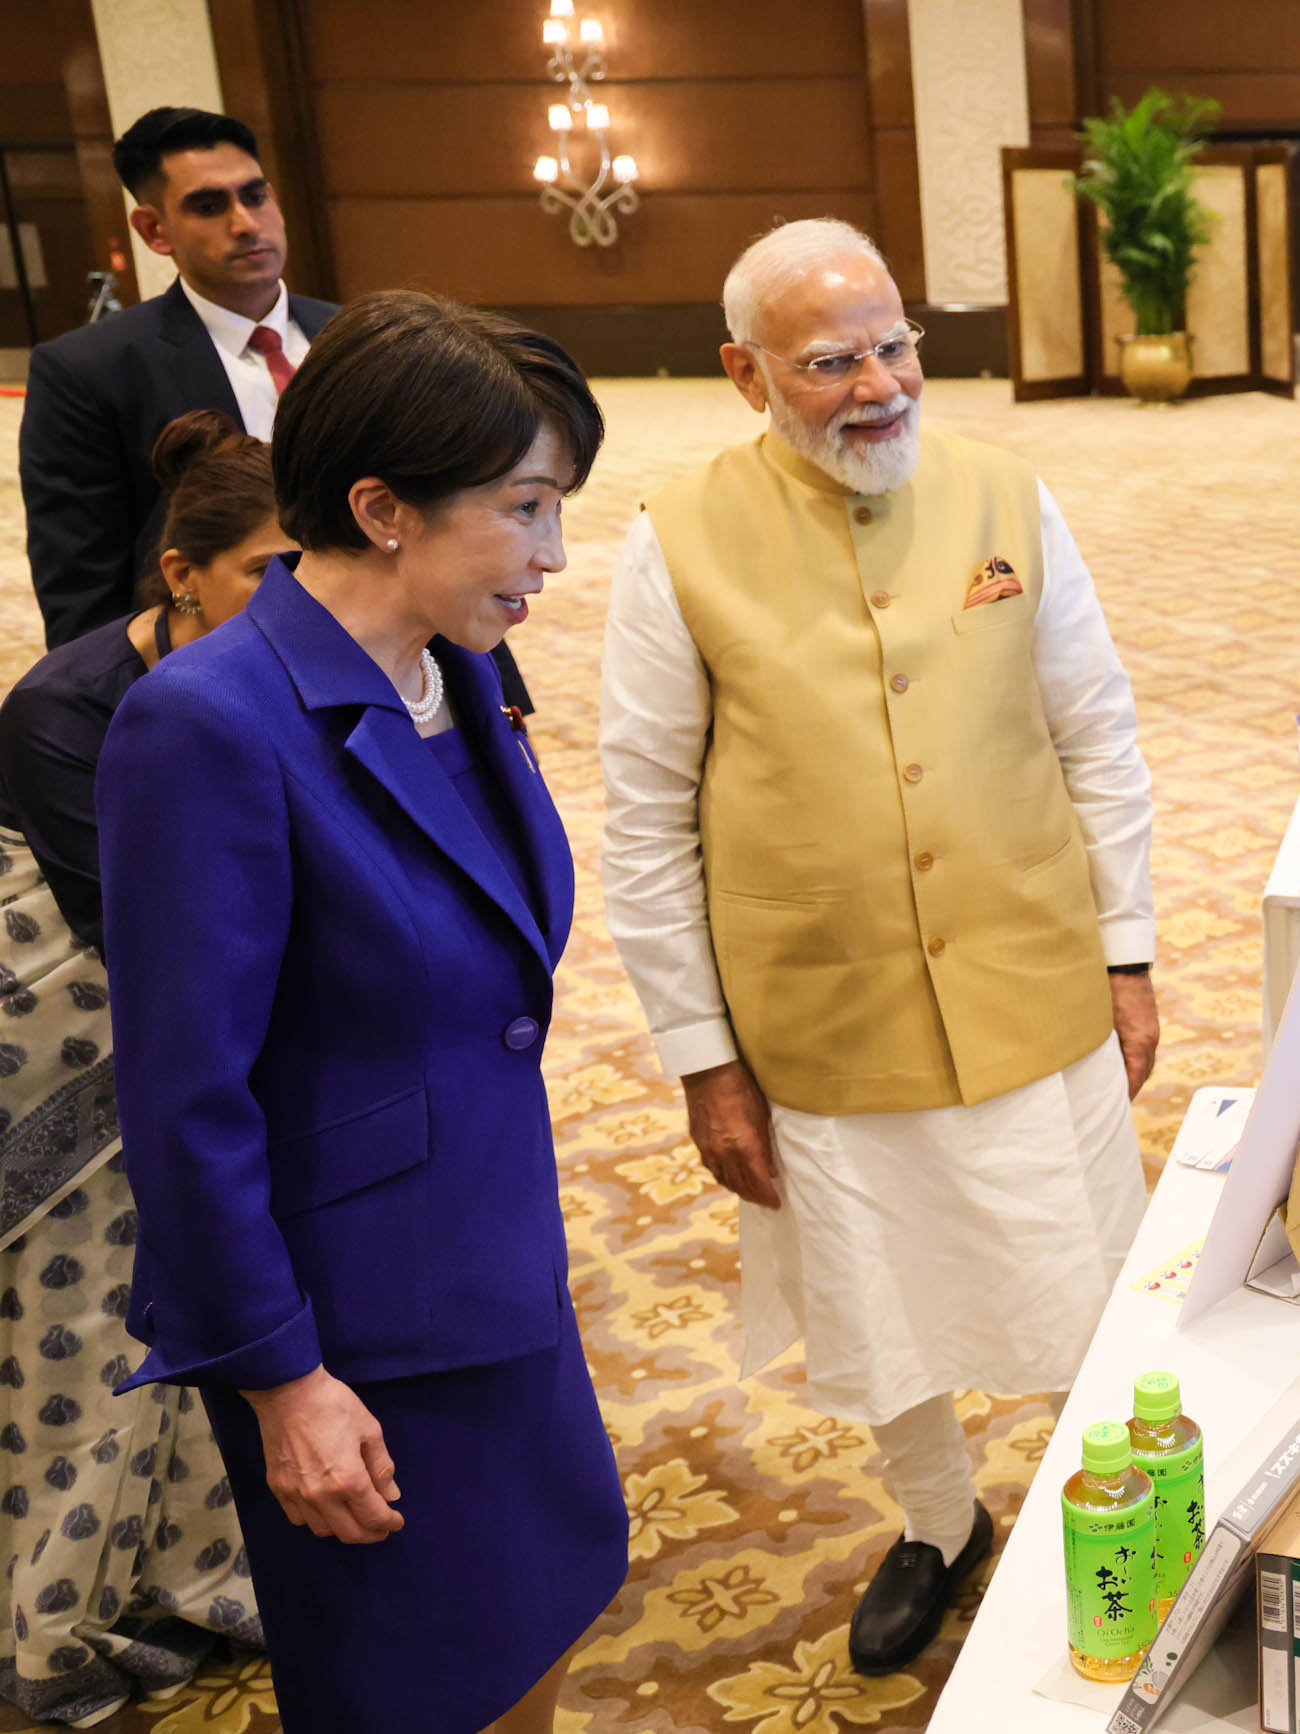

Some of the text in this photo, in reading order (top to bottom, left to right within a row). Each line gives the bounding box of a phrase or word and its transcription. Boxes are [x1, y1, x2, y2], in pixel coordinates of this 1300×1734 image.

[1104, 1518, 1136, 1532] 伊藤園
[1096, 1566, 1133, 1621] お茶
